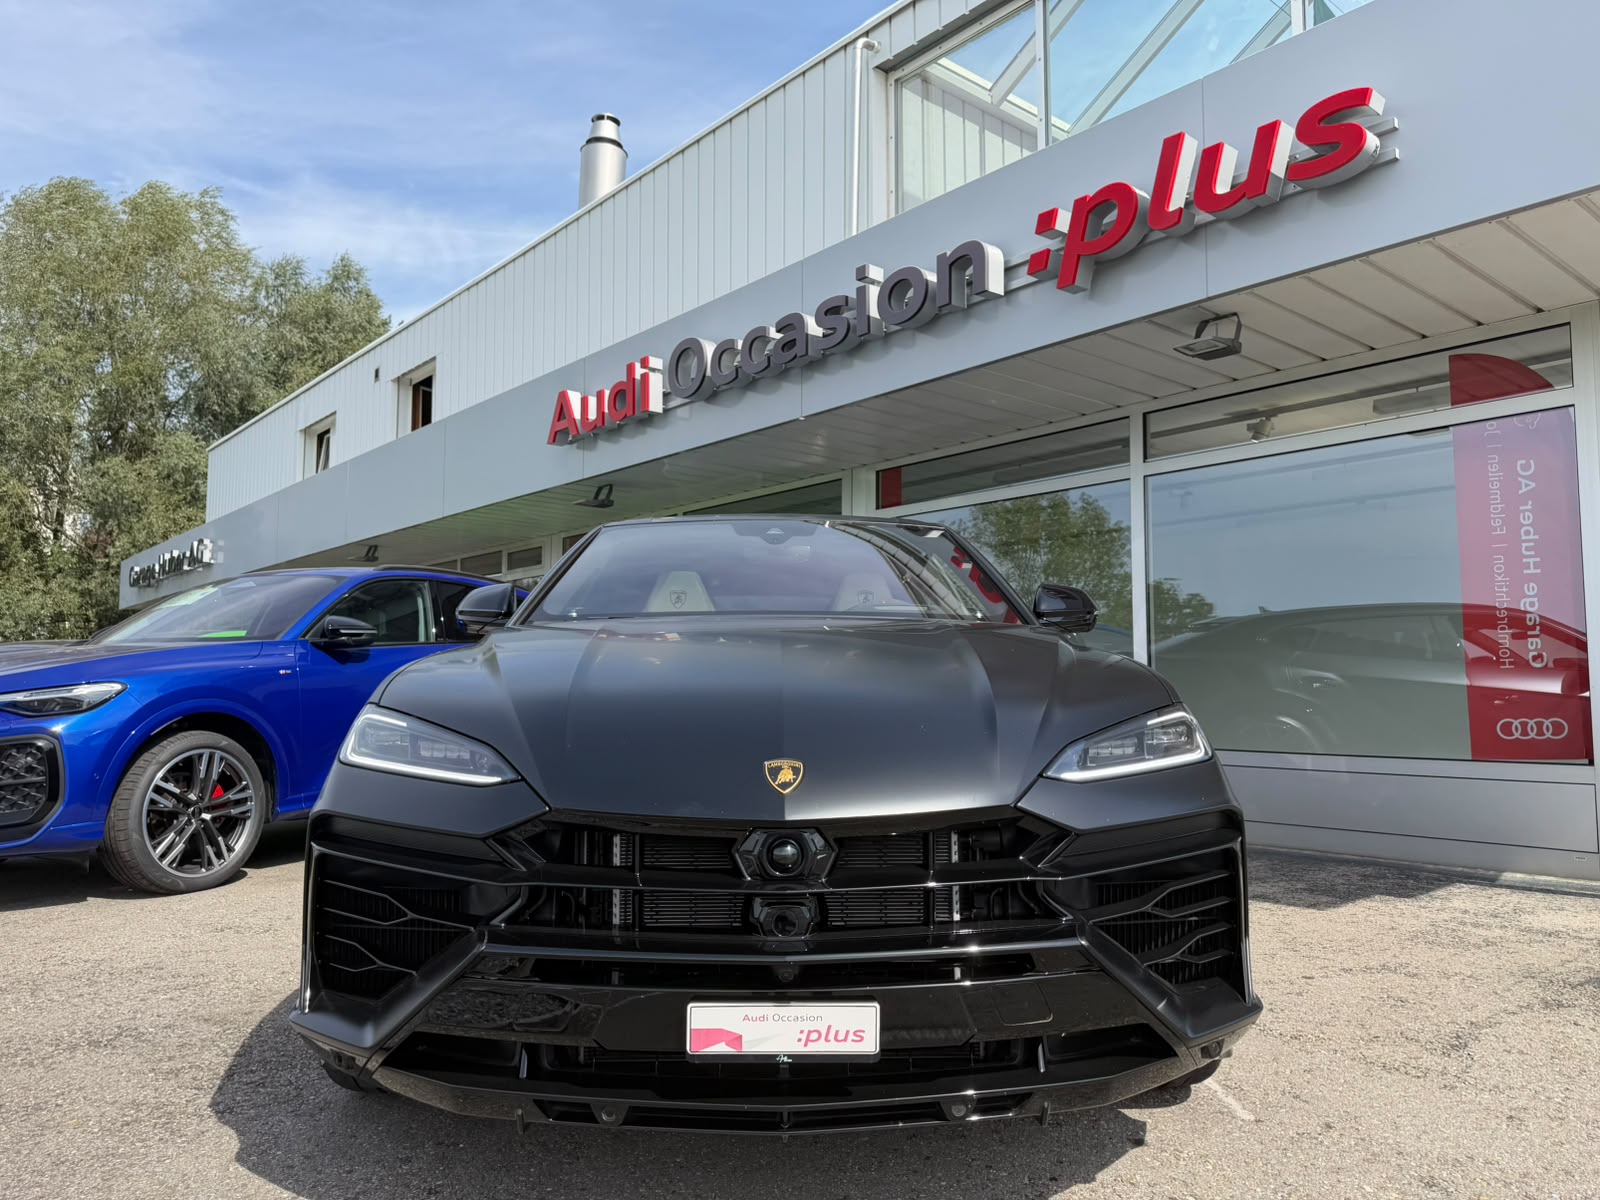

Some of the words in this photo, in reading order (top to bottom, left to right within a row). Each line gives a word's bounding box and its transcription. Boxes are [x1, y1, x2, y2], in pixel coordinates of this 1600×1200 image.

[547, 355, 657, 445] Audi
[668, 239, 1000, 399] Occasion
[1027, 87, 1381, 292] :plus
[188, 538, 210, 567] AG
[742, 1014, 769, 1022] Audi
[772, 1013, 823, 1023] Occasion
[797, 1025, 866, 1047] :plus
